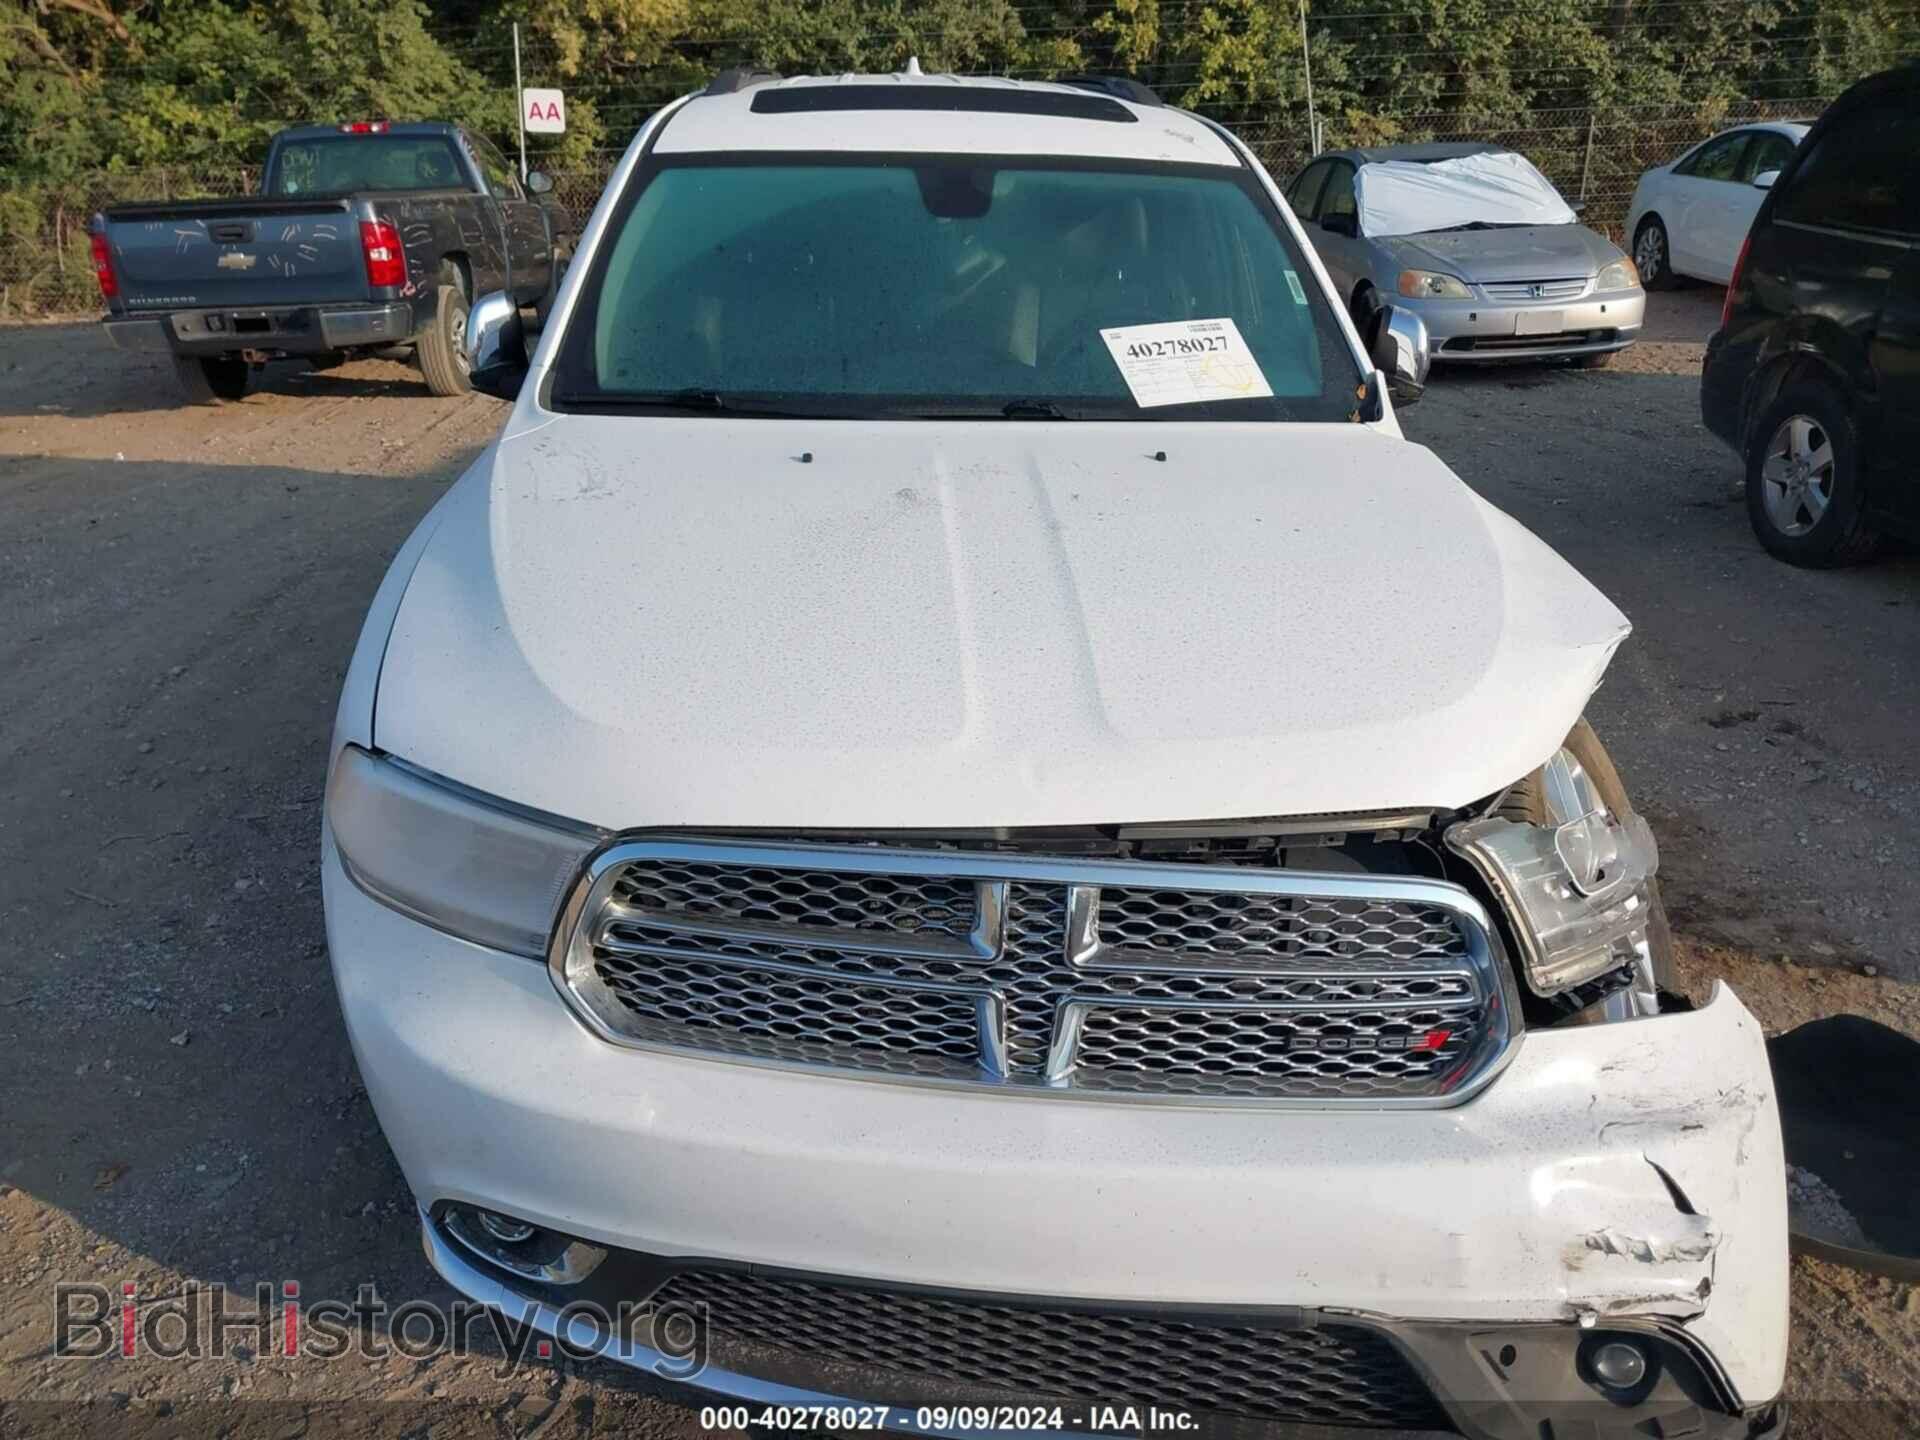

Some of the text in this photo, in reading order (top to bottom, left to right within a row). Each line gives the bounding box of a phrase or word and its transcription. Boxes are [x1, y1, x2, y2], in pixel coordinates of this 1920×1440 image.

[529, 102, 561, 120] AA
[1125, 336, 1228, 359] 40278027
[1288, 1036, 1430, 1051] DODGE
